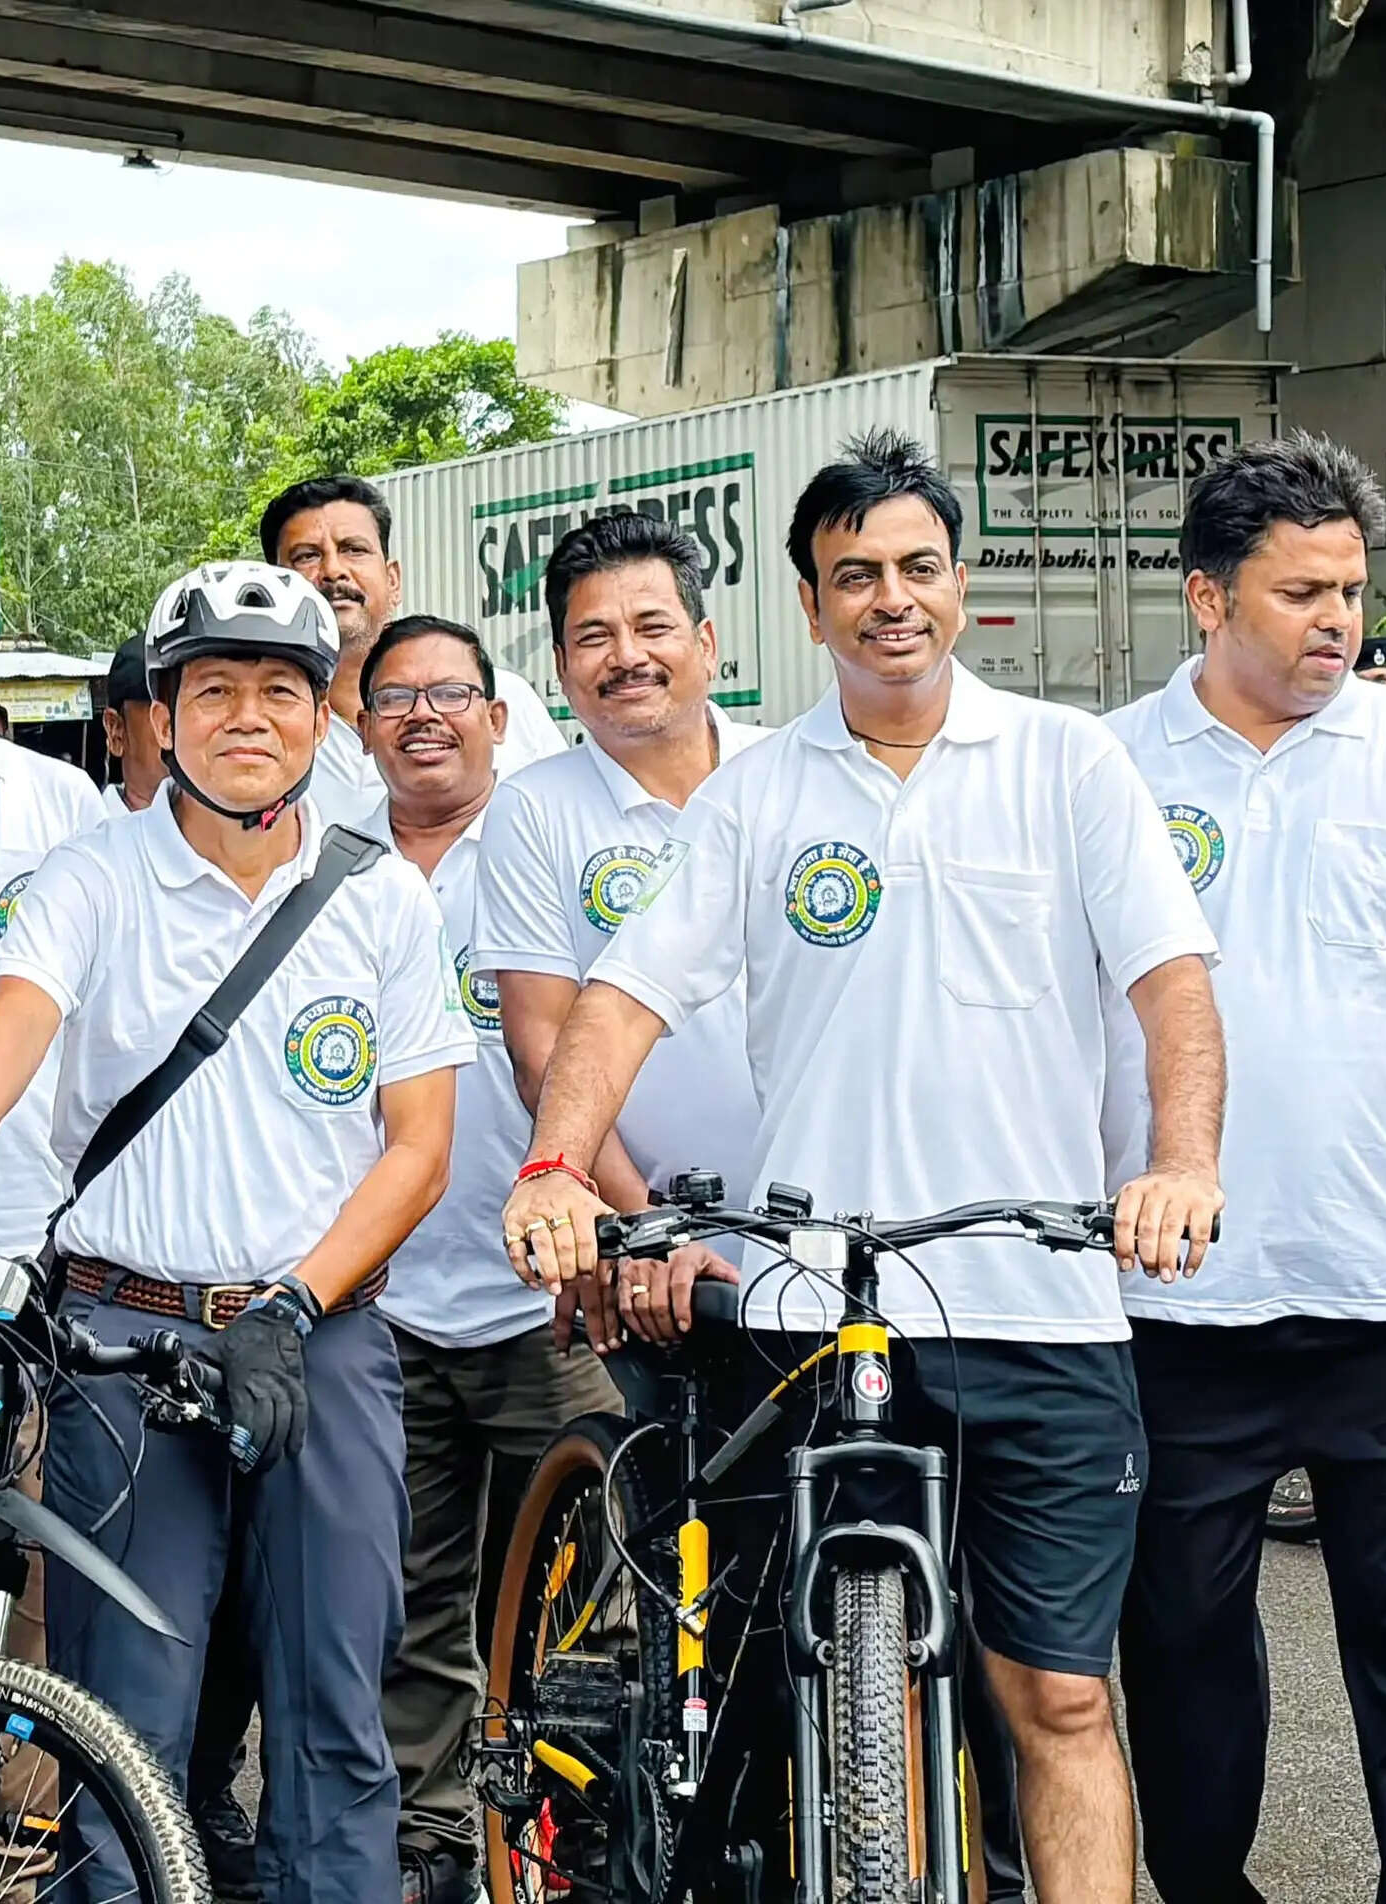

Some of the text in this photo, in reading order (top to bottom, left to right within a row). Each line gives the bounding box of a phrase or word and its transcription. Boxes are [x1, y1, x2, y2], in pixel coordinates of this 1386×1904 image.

[993, 508, 1012, 519] THE
[1085, 508, 1148, 519] LGISICS
[1159, 508, 1180, 519] SOL
[978, 548, 1180, 570] Distrbution Rede
[865, 1373, 884, 1391] H
